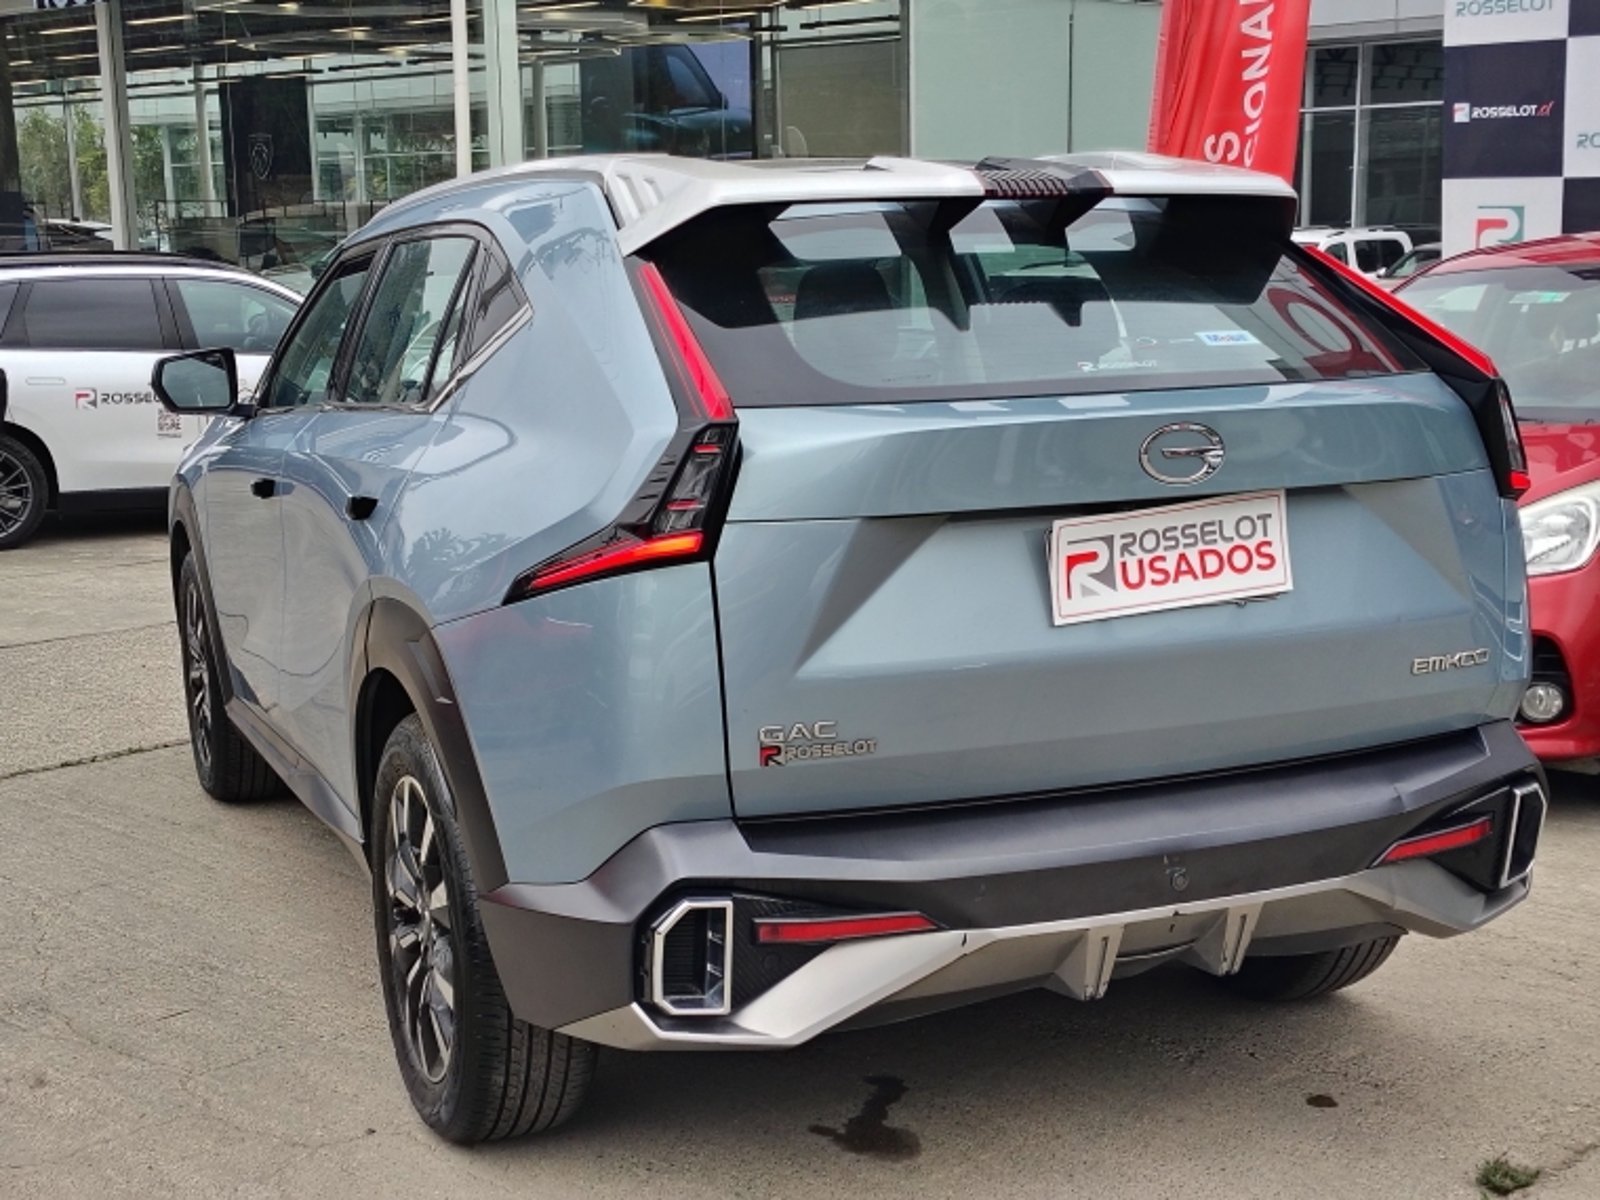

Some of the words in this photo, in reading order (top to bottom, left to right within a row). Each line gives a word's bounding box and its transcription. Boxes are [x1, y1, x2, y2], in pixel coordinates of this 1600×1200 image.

[1120, 513, 1272, 557] ROSSELOT
[1120, 540, 1277, 590] USADOS
[759, 720, 838, 742] GAC
[785, 740, 877, 761] ROSSELOT
